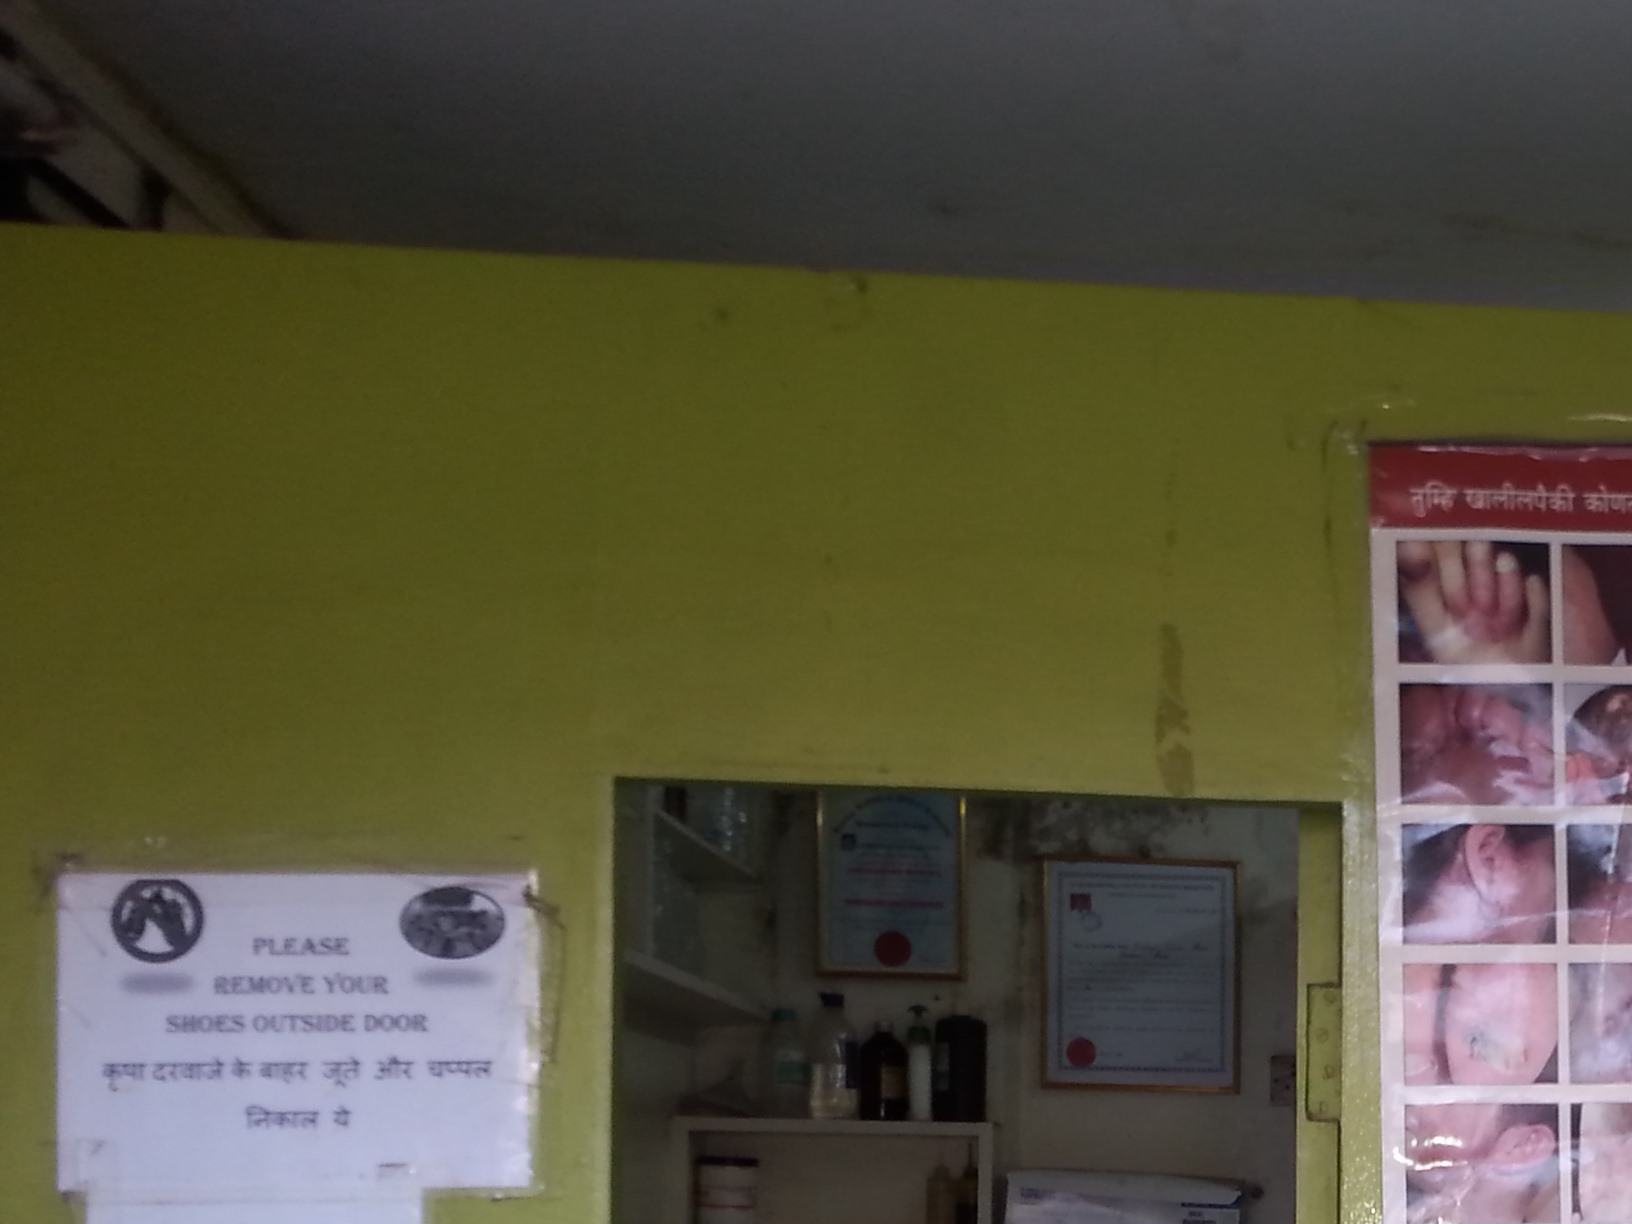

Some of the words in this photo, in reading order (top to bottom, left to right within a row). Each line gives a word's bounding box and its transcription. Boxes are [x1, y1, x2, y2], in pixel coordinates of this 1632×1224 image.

[253, 936, 350, 957] PLEASE
[213, 974, 316, 996] REMOVE
[322, 974, 390, 996] YOUR
[165, 1014, 245, 1033] SHOES
[252, 1014, 356, 1033] OUTSIDE
[363, 1013, 429, 1033] DOOR
[152, 1056, 224, 1081] दरवाजे
[231, 1056, 253, 1080] के
[258, 1060, 308, 1084] बाहर
[321, 1056, 362, 1087] जूते
[374, 1055, 415, 1080] और
[427, 1059, 493, 1079] चप्पल
[245, 1104, 319, 1129] निकाल
